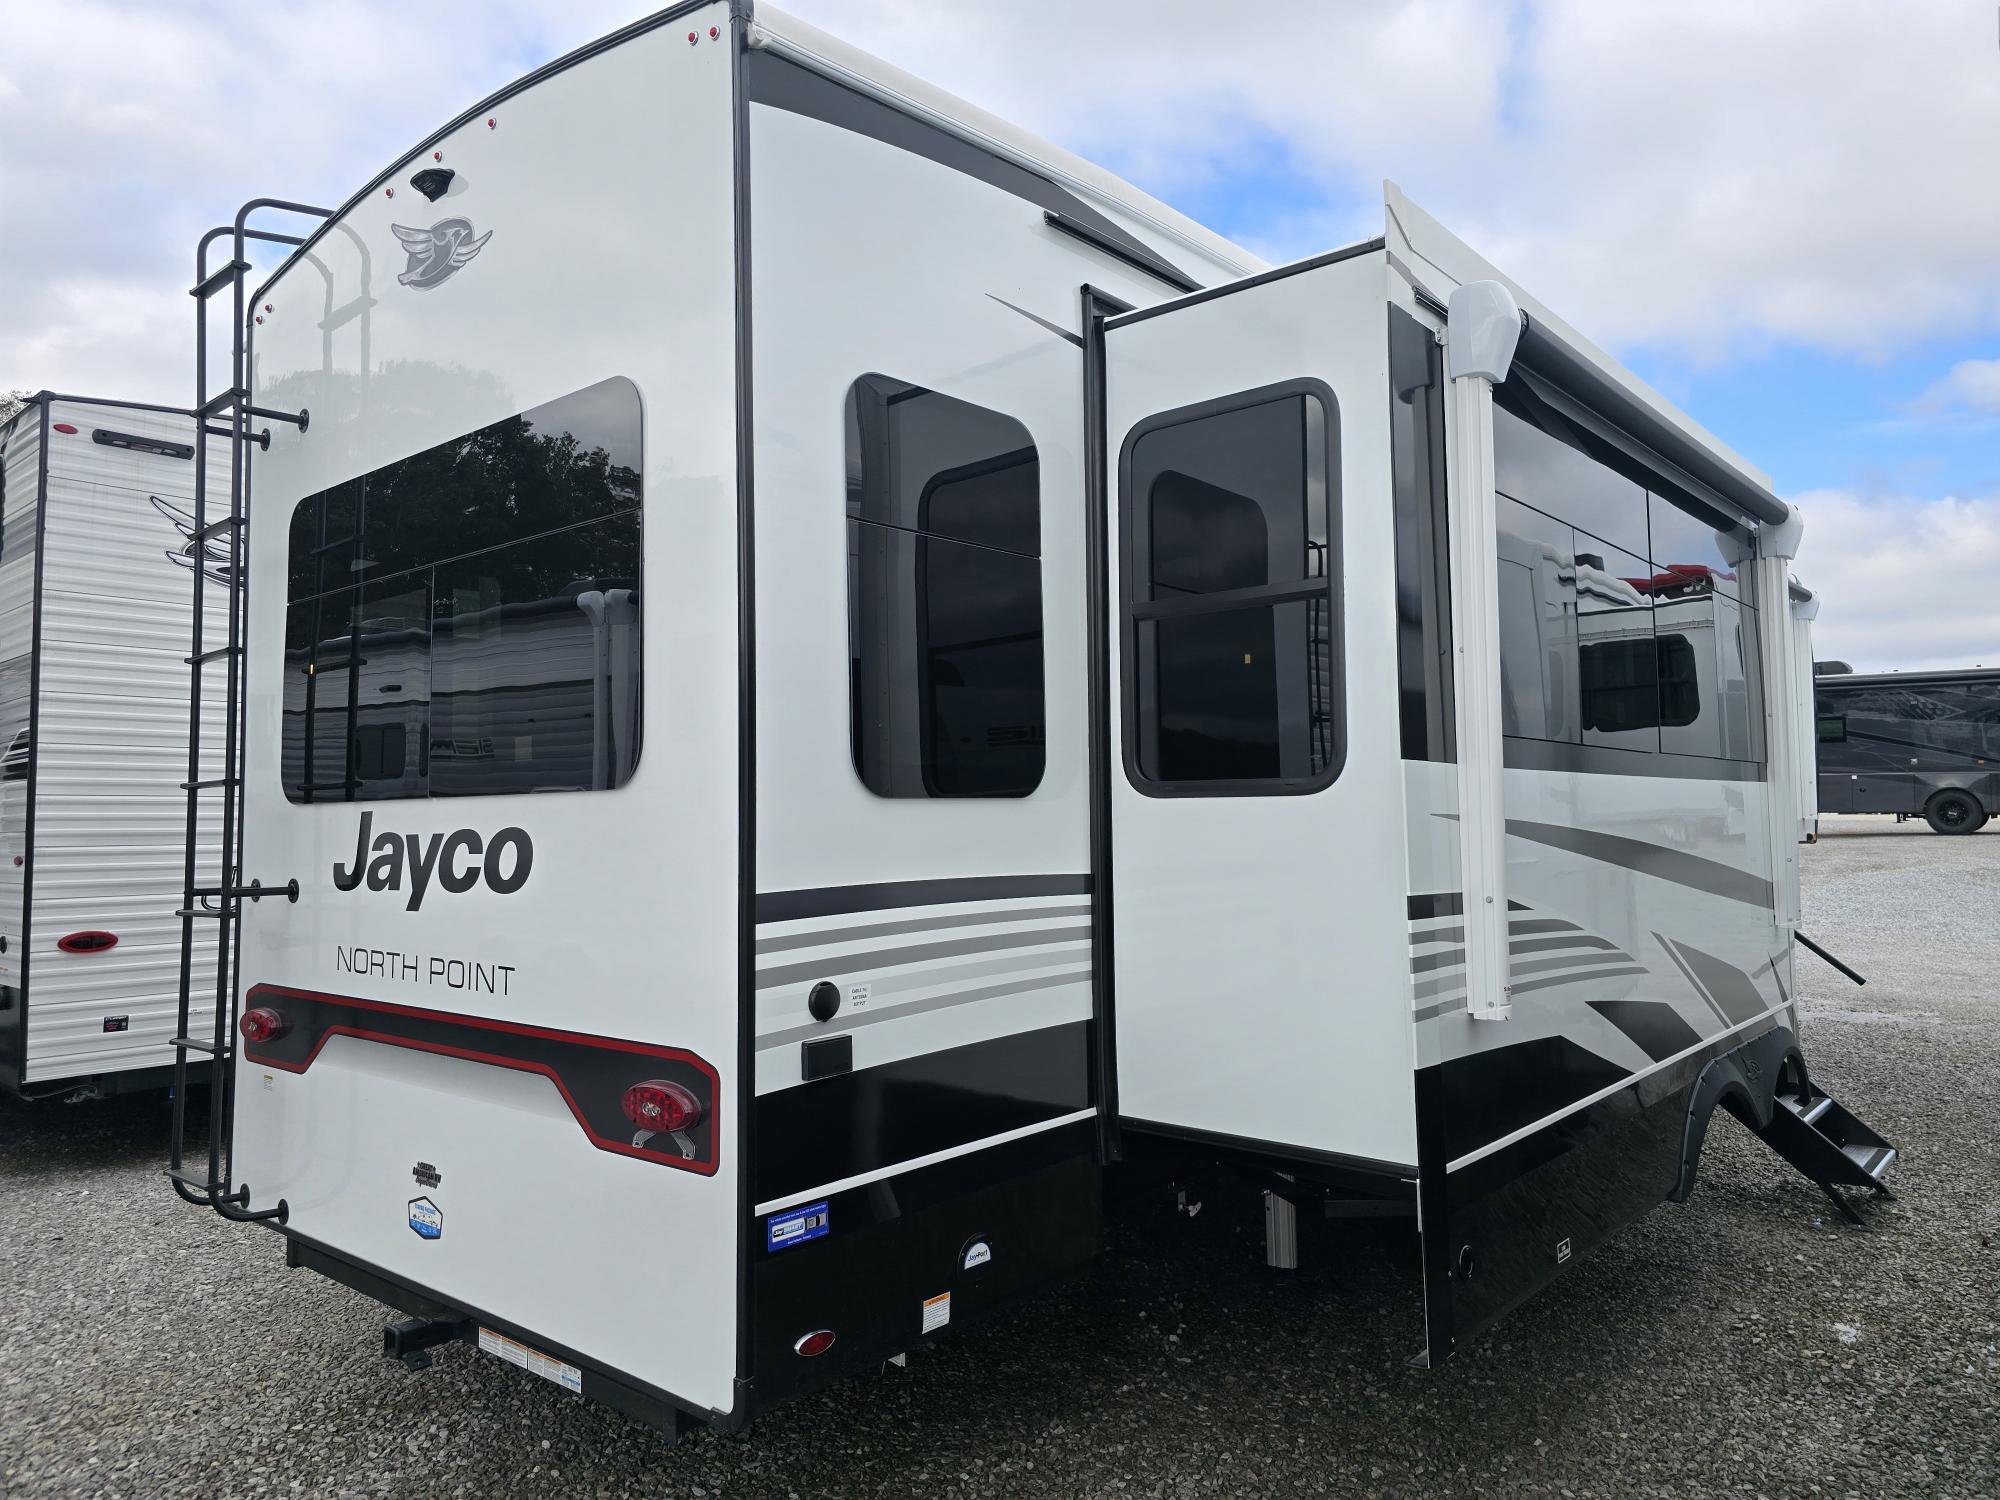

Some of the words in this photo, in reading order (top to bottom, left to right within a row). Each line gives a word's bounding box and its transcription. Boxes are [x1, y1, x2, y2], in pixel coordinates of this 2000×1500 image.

[333, 811, 534, 911] Jayco
[337, 946, 418, 982] NORTH
[429, 957, 516, 995] POINT
